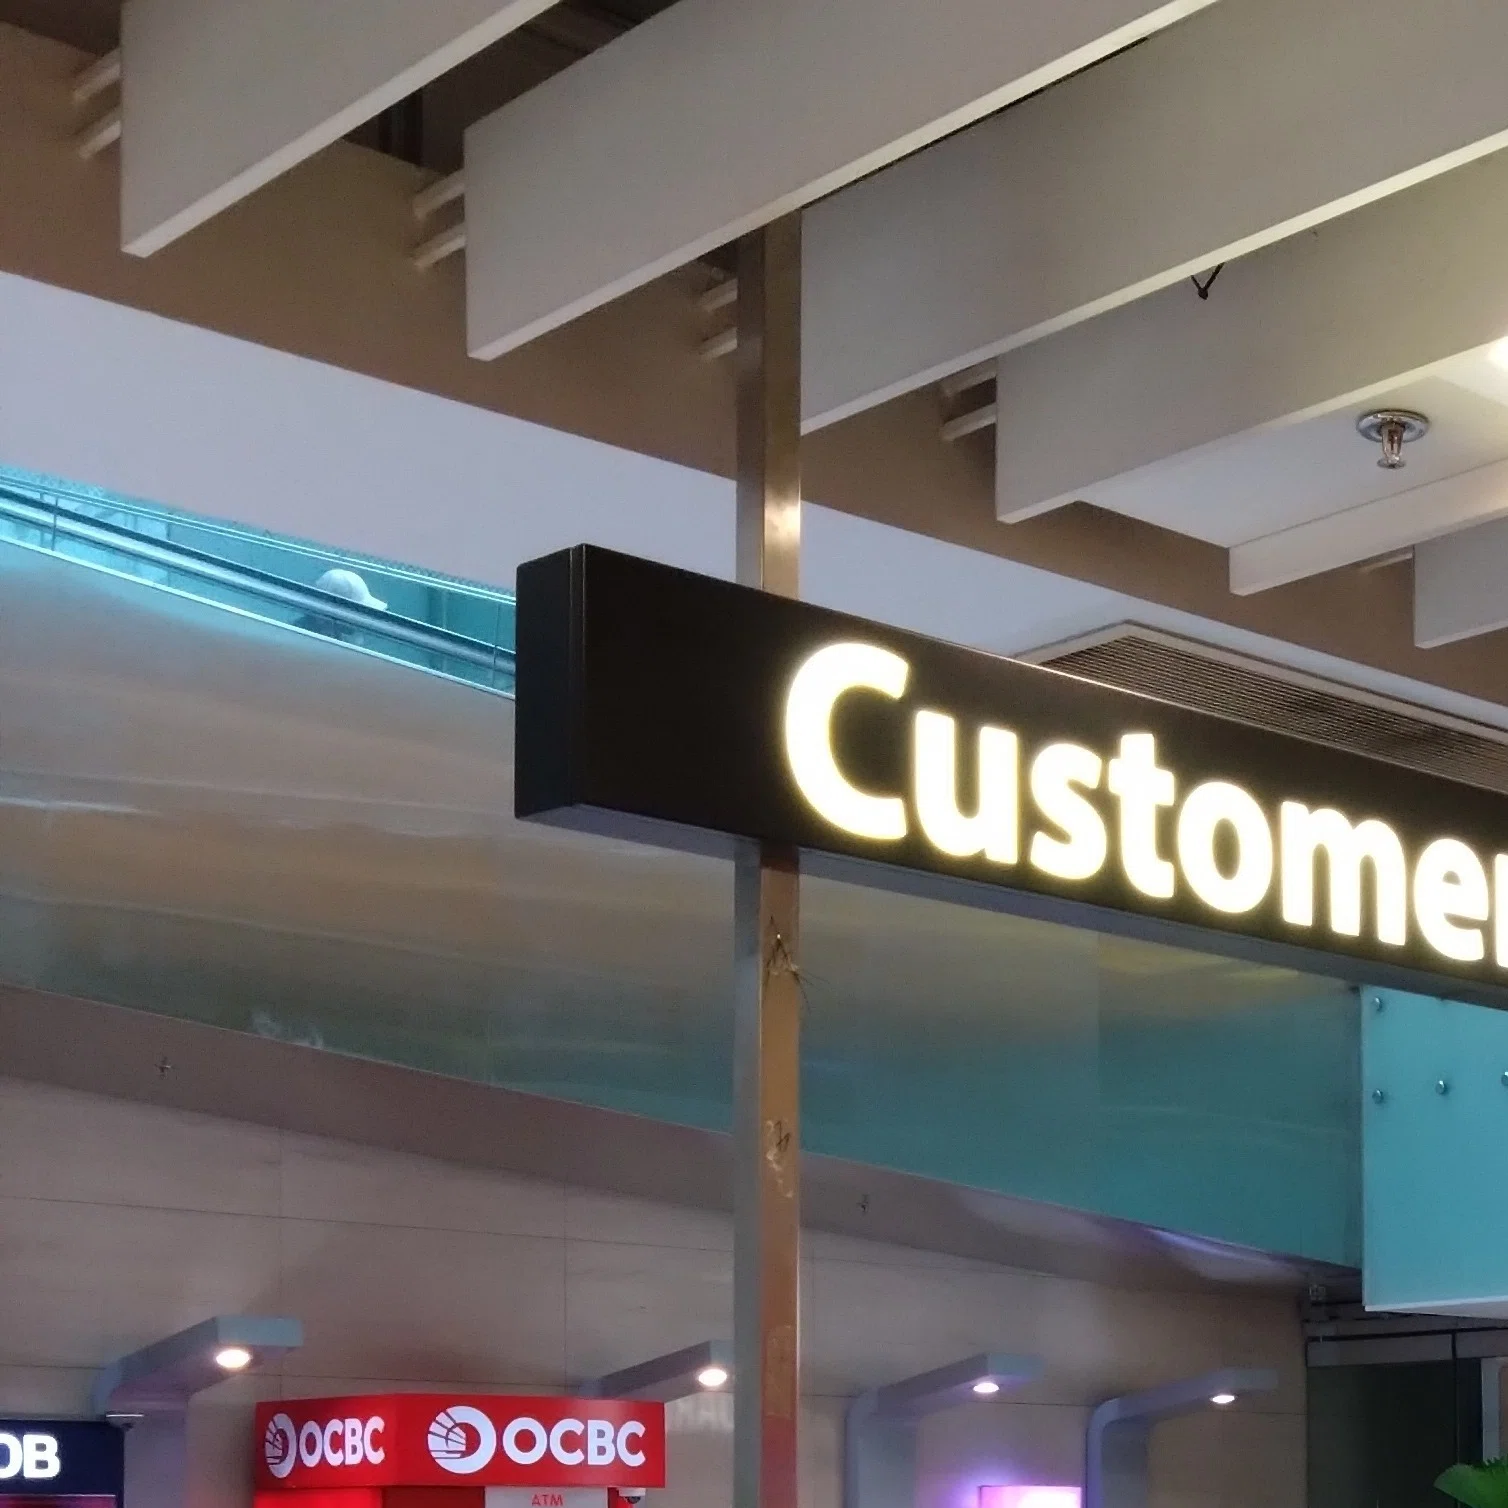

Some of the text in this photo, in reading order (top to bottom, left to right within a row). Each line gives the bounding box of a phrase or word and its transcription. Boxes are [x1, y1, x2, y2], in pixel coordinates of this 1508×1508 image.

[300, 1415, 386, 1467] OCBC
[502, 1416, 647, 1467] OCBC
[531, 1494, 564, 1507] ATM
